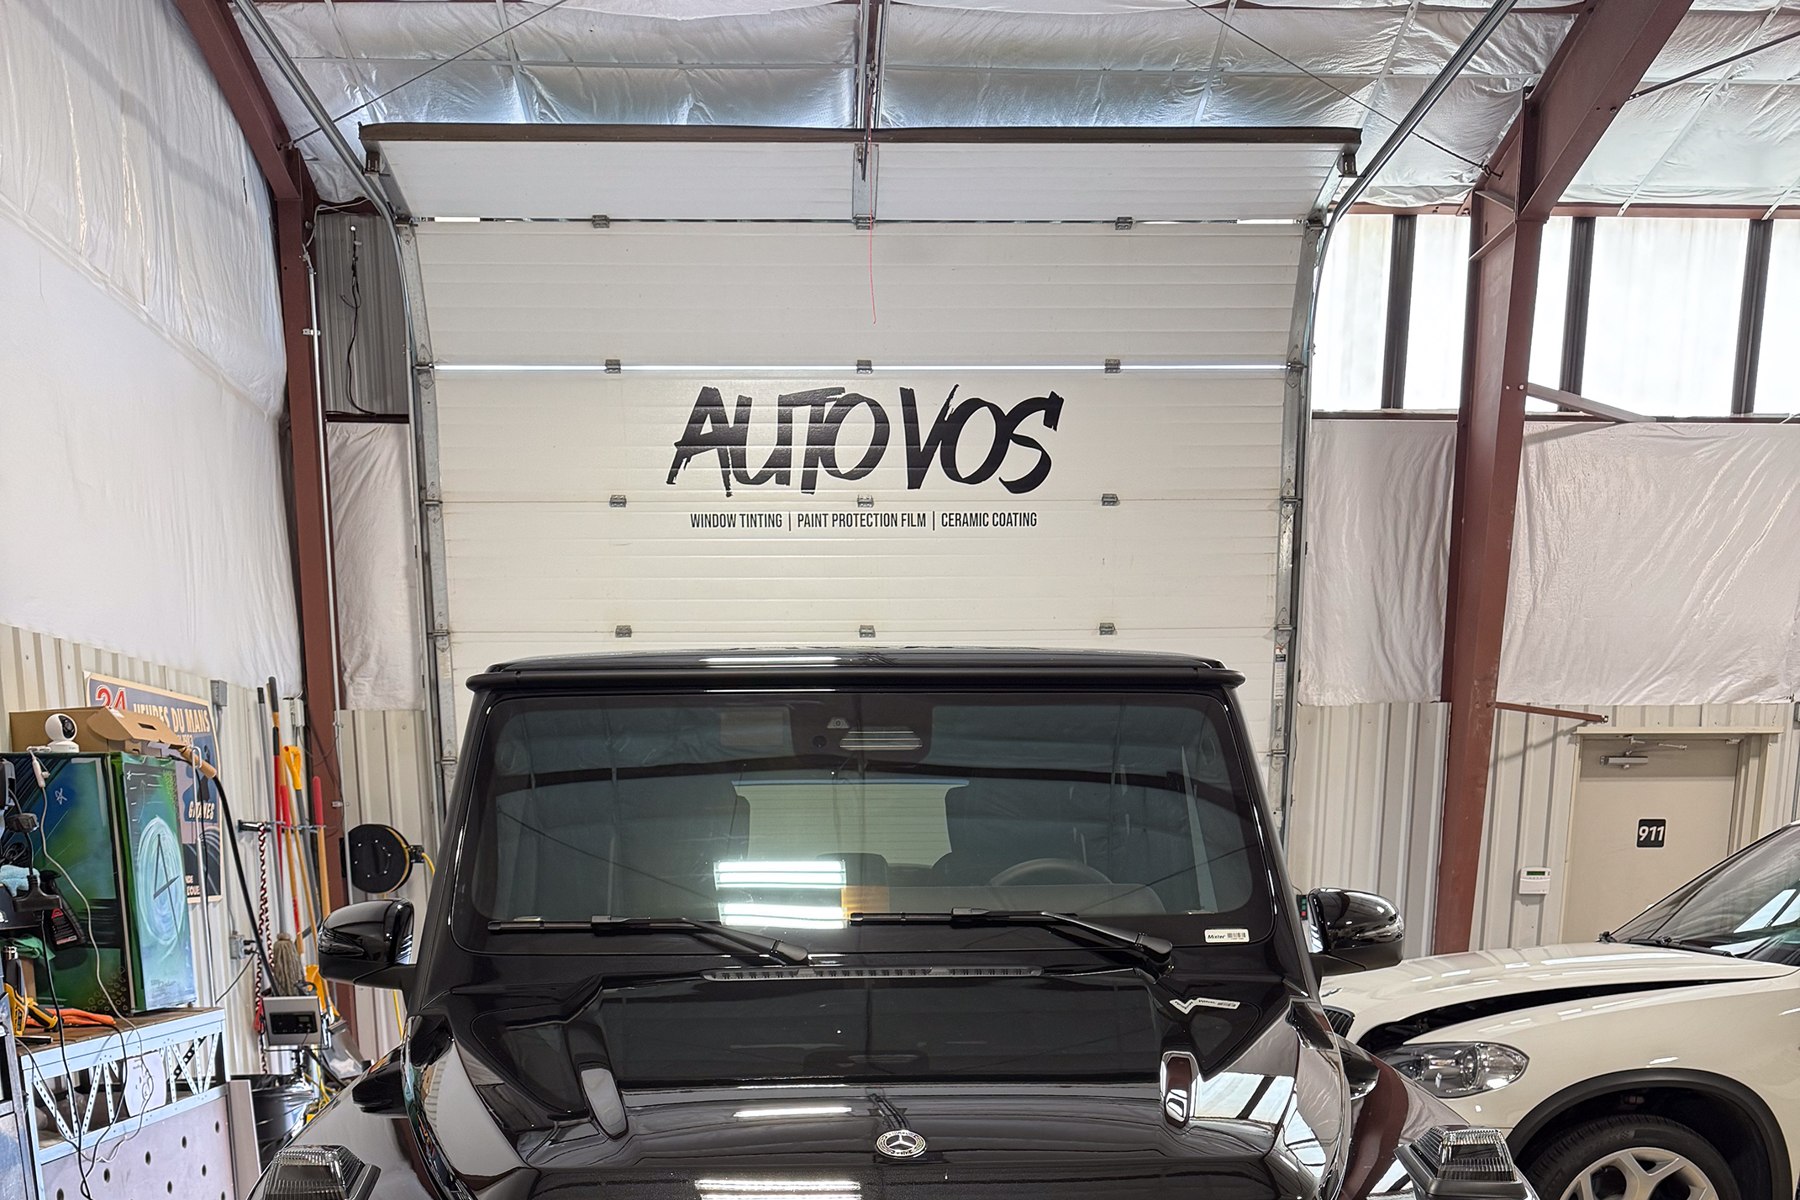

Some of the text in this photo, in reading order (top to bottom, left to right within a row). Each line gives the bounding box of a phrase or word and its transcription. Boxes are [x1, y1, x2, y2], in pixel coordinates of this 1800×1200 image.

[666, 384, 1064, 498] AUTO VOS
[690, 512, 1037, 528] WINDOW TINTING PAINT PROTECTION FILM CERAMIC COATING
[170, 707, 185, 733] DU
[184, 708, 211, 733] MANS
[1639, 826, 1665, 841] 911
